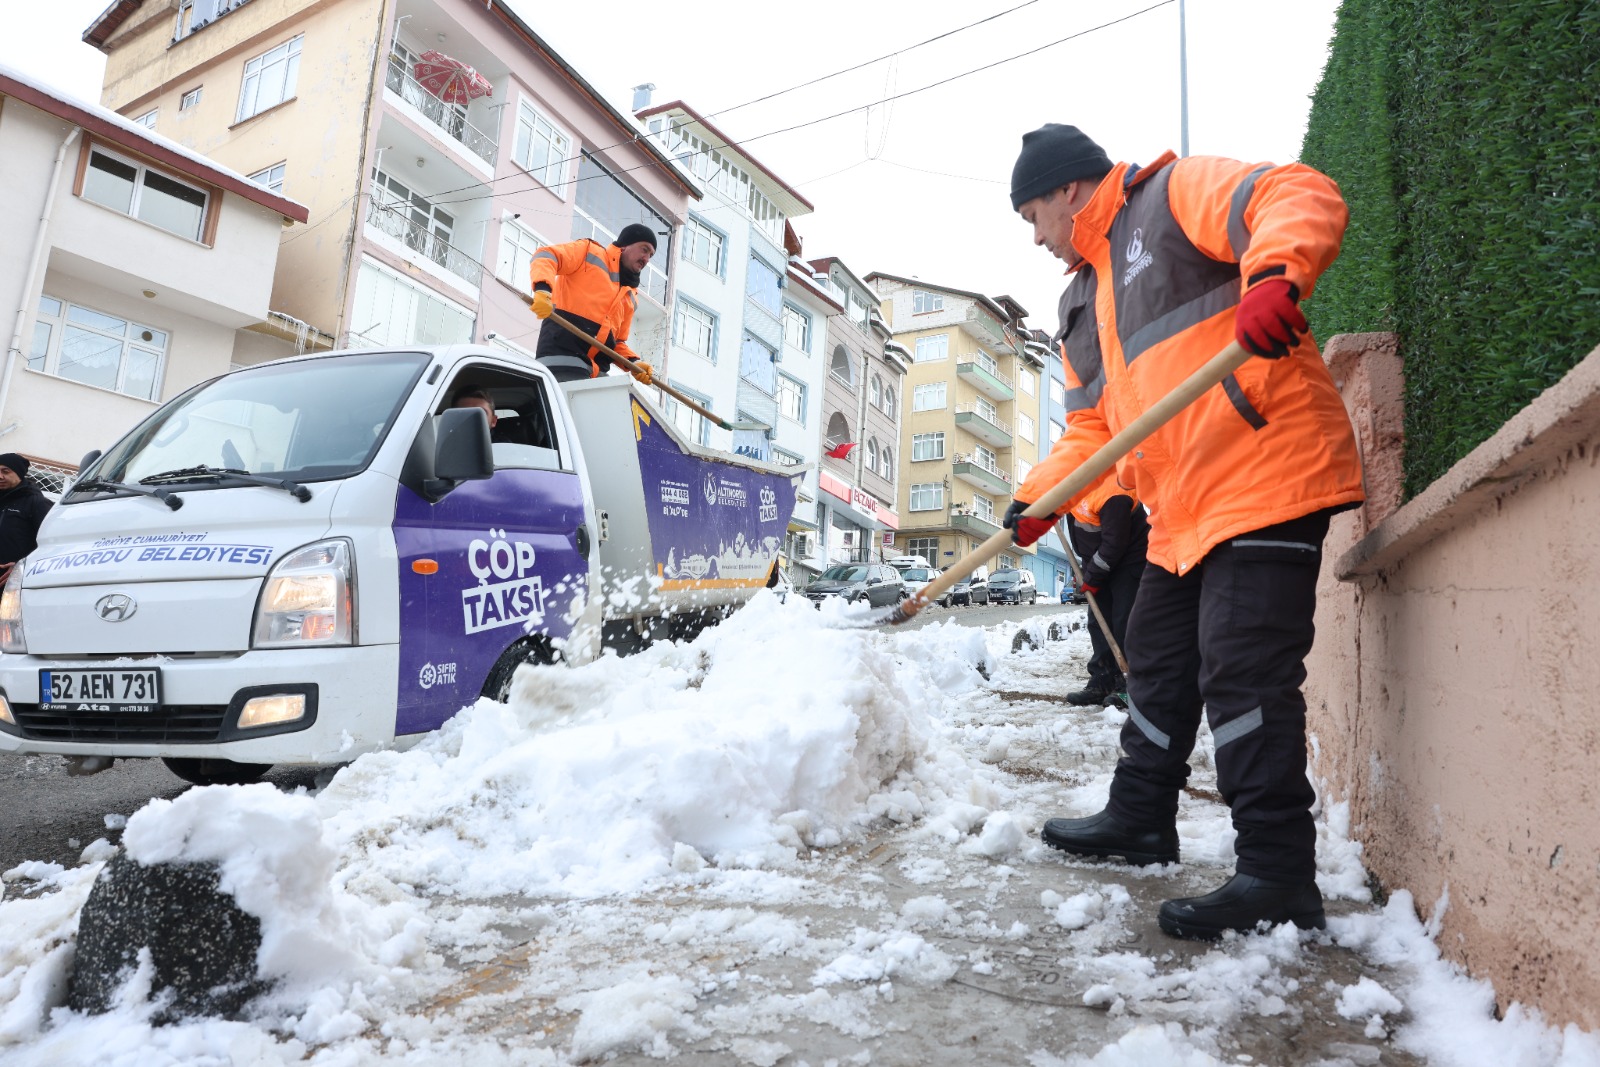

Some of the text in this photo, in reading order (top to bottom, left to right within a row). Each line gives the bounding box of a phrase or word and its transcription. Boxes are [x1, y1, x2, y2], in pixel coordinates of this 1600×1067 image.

[760, 485, 776, 506] ÇÖP
[93, 532, 208, 549] TÜRKİYE CUMHURİYETİ
[26, 546, 273, 577] ALTINORDU BELEDİYESİ
[468, 528, 535, 587] ÇÖP
[464, 583, 542, 628] TAKSİ
[437, 662, 457, 674] SIFIR
[437, 672, 457, 685] ATIK
[51, 673, 155, 699] 52 AEN 731
[77, 703, 110, 711] Ata
